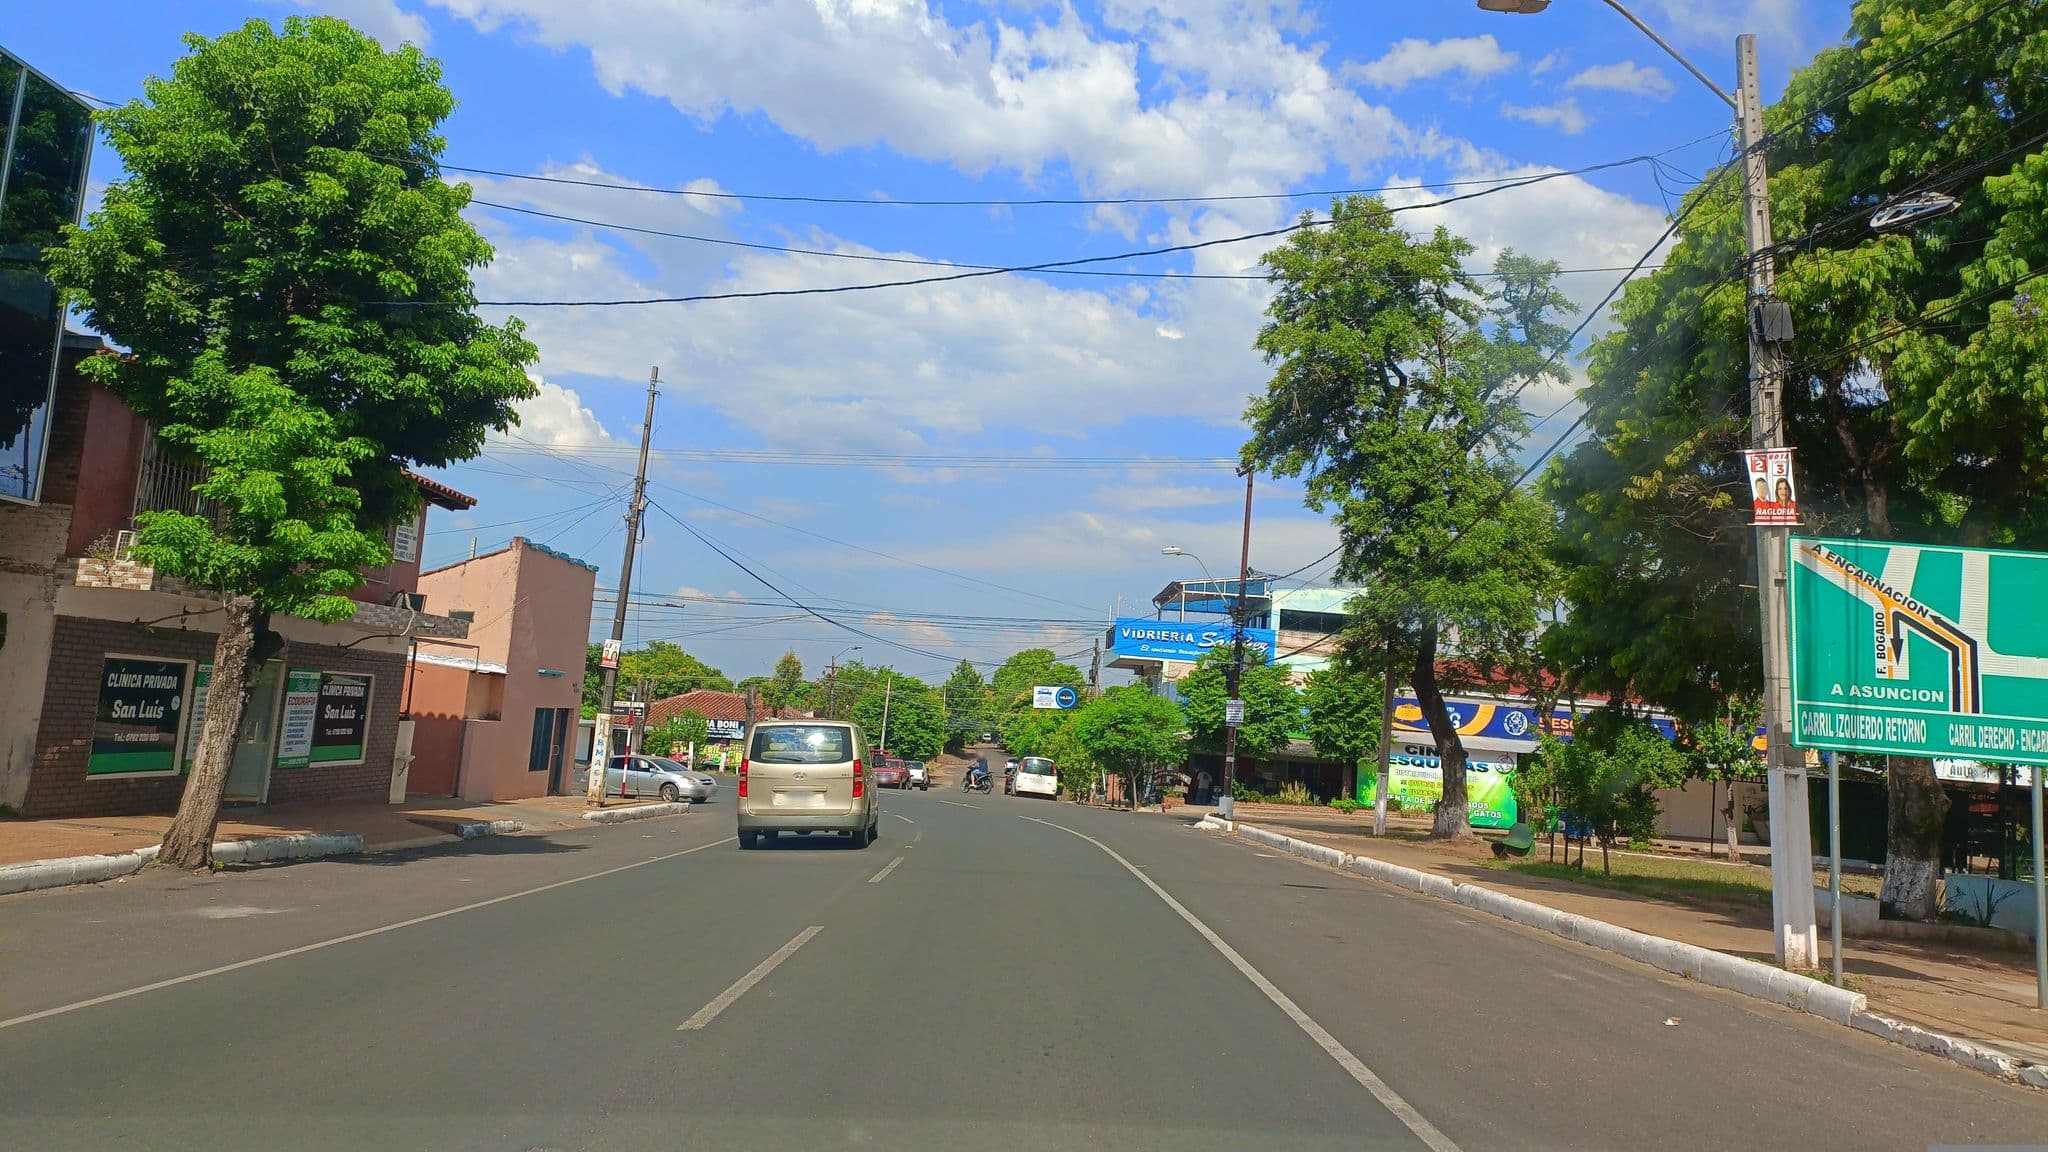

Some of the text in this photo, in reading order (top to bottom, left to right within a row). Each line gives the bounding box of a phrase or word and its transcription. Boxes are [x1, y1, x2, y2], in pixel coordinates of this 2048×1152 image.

[1755, 461, 1764, 471] 2
[1777, 464, 1784, 474] 3
[1812, 543, 1929, 618] A ENCARNACION
[1875, 612, 1887, 674] F. BOGADO
[107, 667, 178, 690] CLÍNICA PRIVADA
[1831, 683, 1944, 703] A ASUNCION
[112, 699, 164, 719] San Luis
[324, 704, 356, 719] San Luis
[716, 720, 739, 729] BONI
[1801, 710, 1927, 744] CARRIL IZQUIERDO RETORNO
[1948, 723, 1977, 748] CARRIL
[1978, 726, 2015, 751] DERECHO
[2020, 728, 2048, 753] ENCAR
[1388, 754, 1489, 773] ESQUAS
[1414, 796, 1425, 804] DE
[1473, 810, 1502, 819] GATOS
